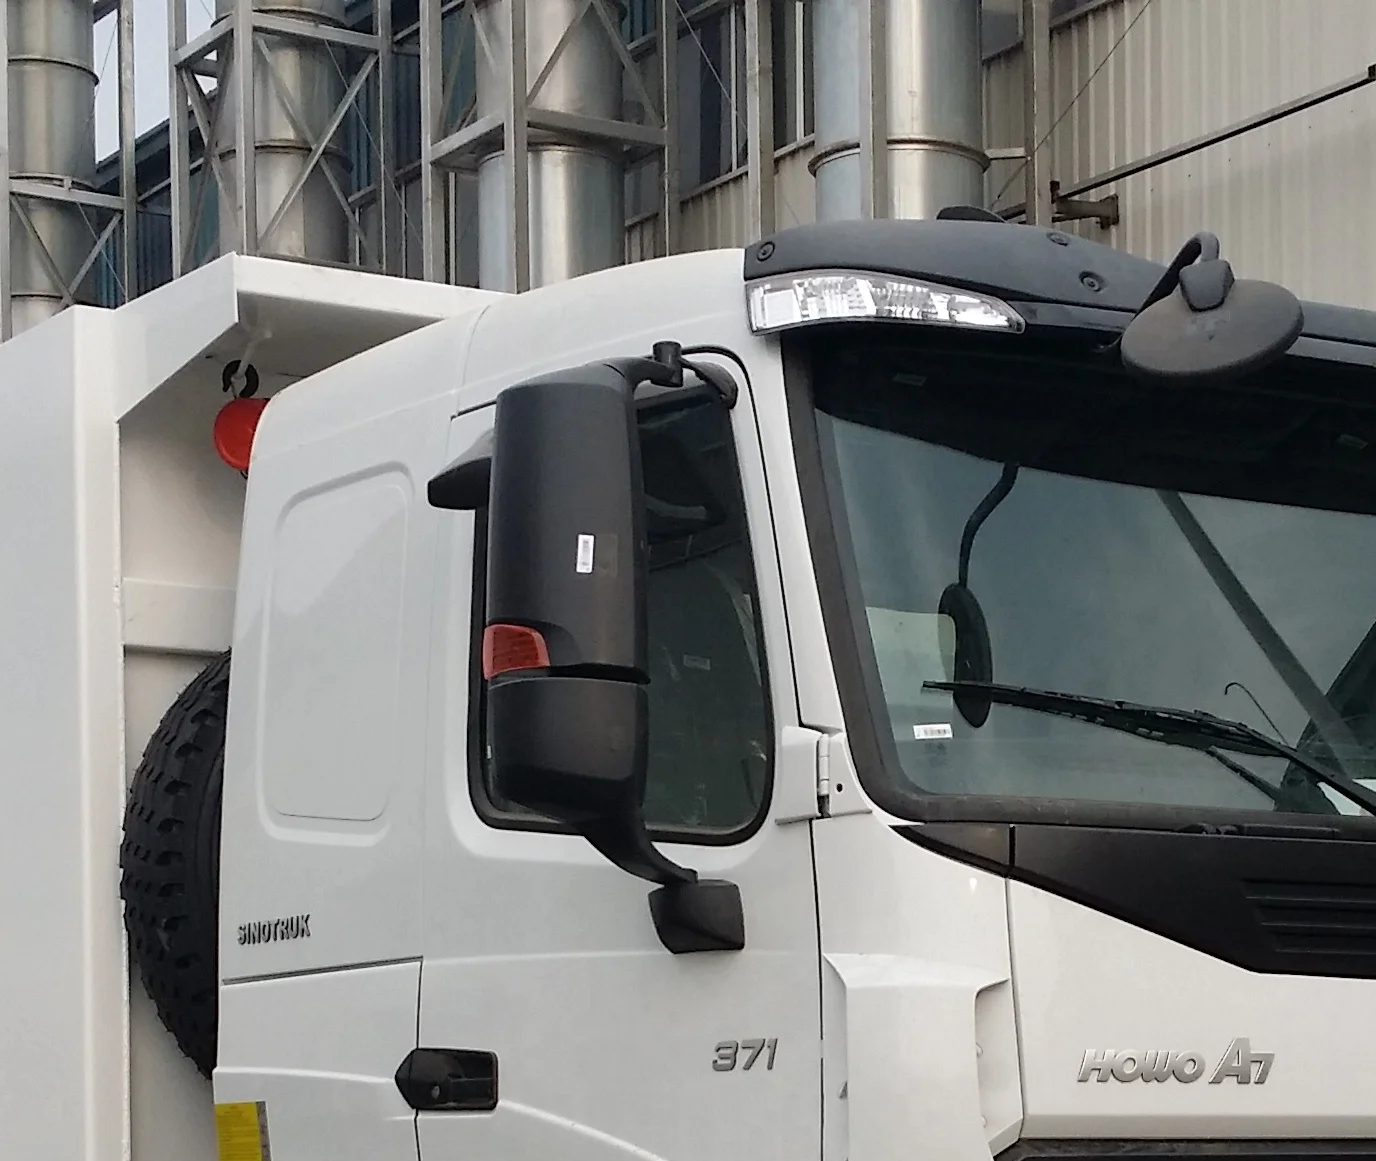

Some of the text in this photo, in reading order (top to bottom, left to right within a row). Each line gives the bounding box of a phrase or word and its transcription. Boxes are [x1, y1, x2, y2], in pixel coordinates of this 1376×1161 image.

[237, 913, 311, 945] SINOTRUK
[712, 1038, 778, 1072] 371
[1077, 1036, 1275, 1084] HOWO A7
